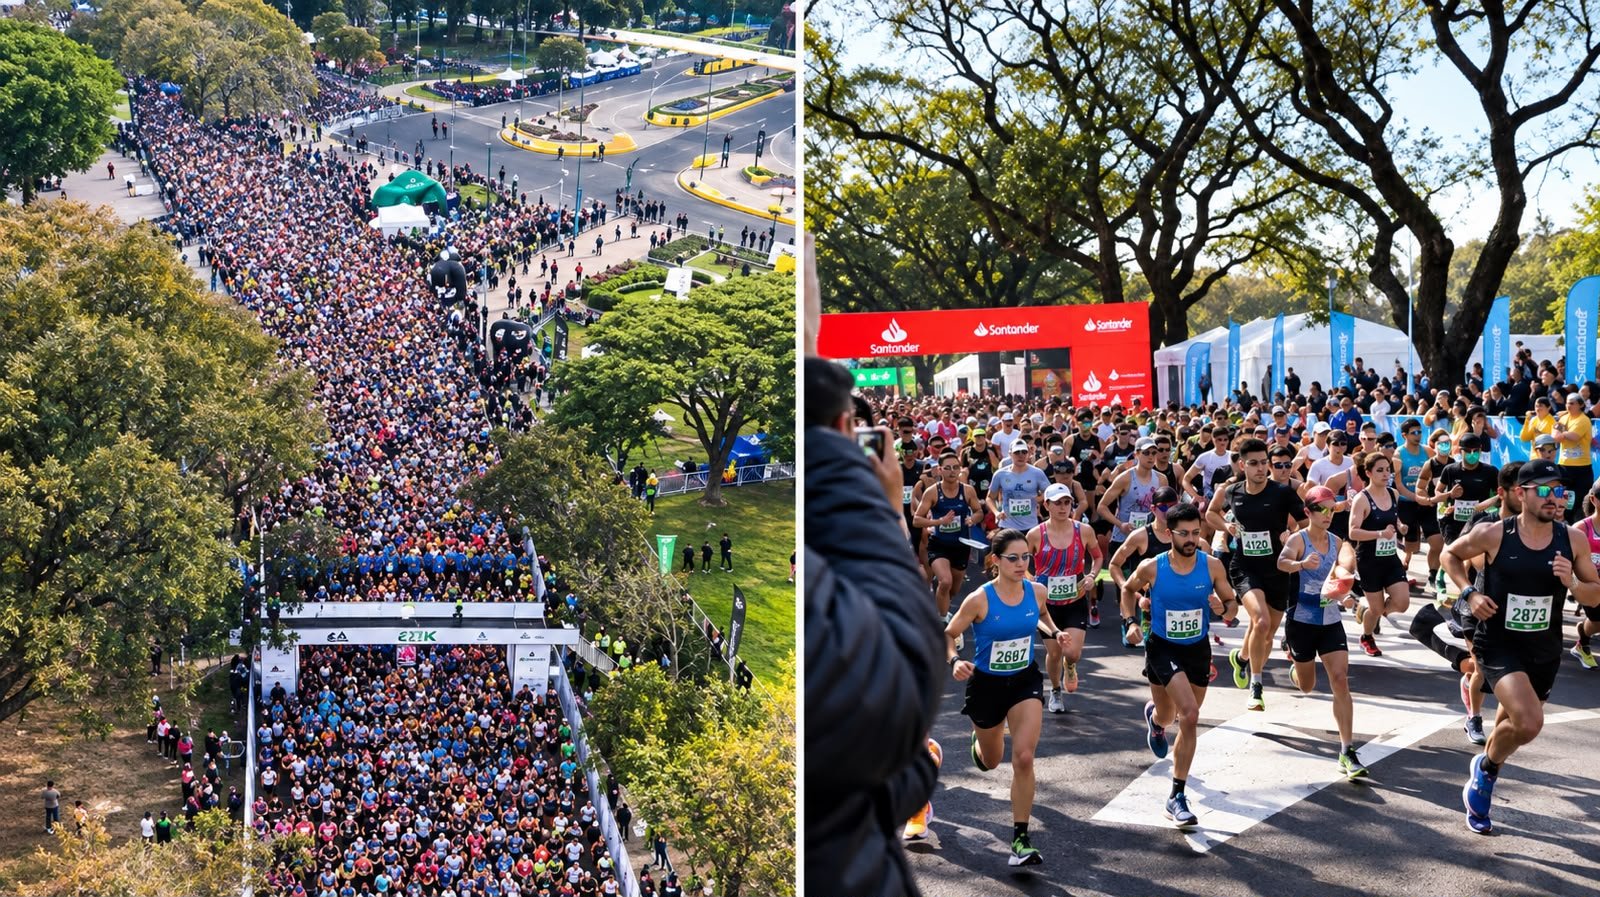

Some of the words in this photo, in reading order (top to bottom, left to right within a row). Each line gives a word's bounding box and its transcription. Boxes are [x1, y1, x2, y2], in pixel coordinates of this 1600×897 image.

[989, 322, 1040, 336] Santander
[870, 343, 920, 355] Santander
[1245, 540, 1268, 550] 4120
[1051, 583, 1074, 594] 2581
[1511, 608, 1547, 622] 2873
[1171, 619, 1199, 631] 3156
[995, 648, 1027, 663] 2687
